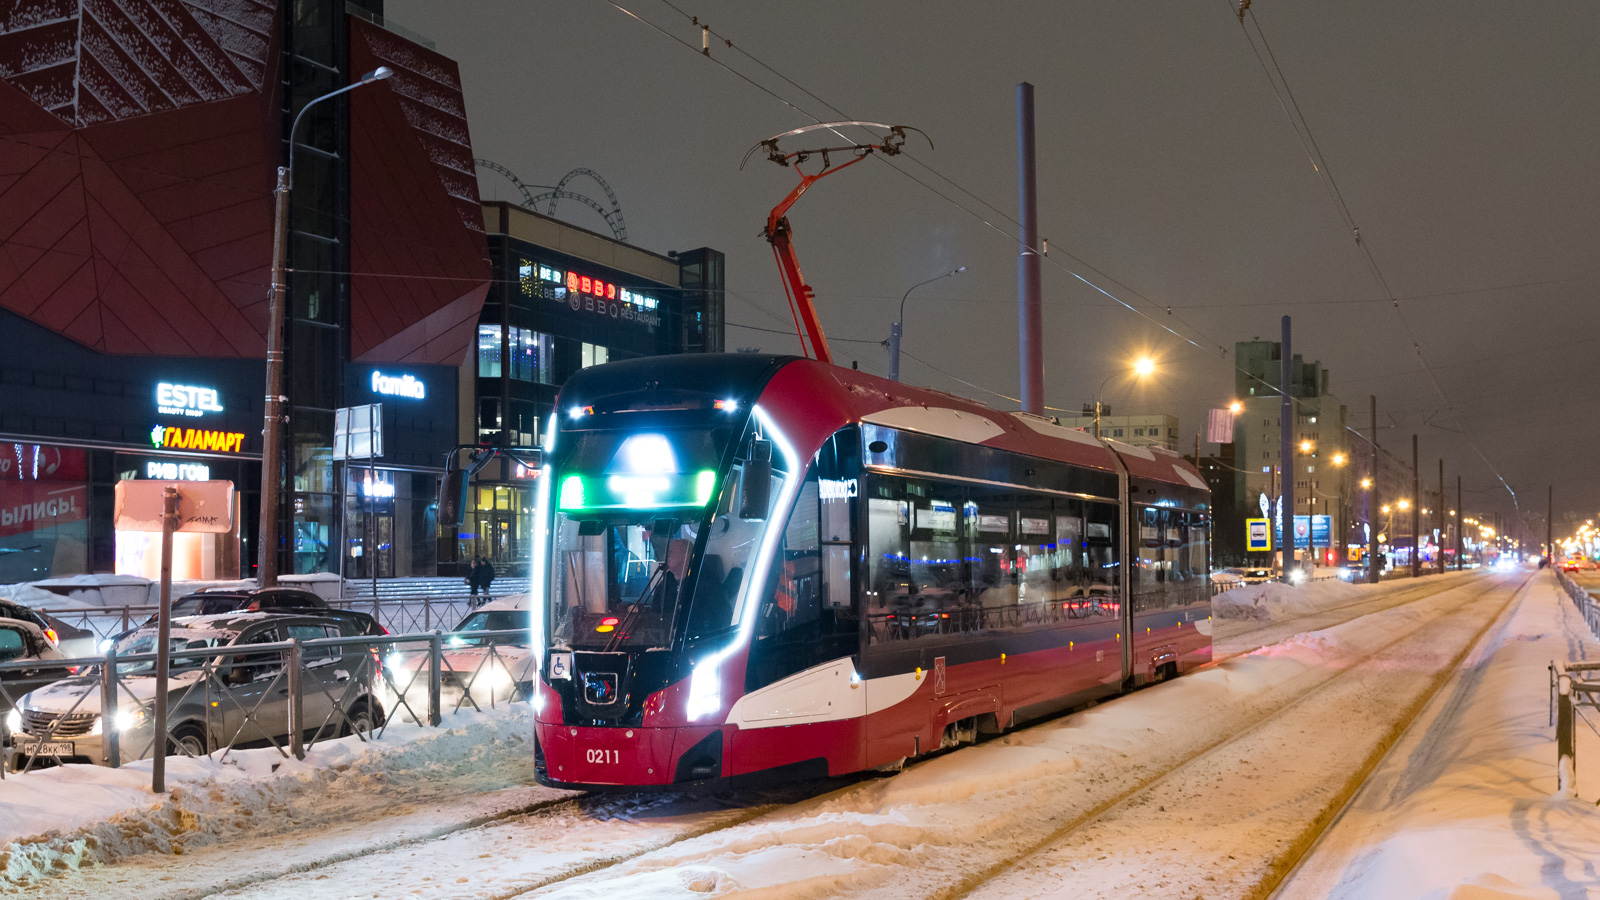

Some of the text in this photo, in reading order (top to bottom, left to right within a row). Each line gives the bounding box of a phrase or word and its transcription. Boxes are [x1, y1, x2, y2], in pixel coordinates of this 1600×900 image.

[585, 296, 618, 320] BBQ
[620, 308, 661, 327] RESTAURANT
[157, 383, 223, 411] ESTEL
[372, 371, 424, 398] familia
[164, 427, 244, 452] ГАЛАМАРТ
[147, 462, 209, 481] РИВ ГОШ
[586, 749, 619, 764] 0211
